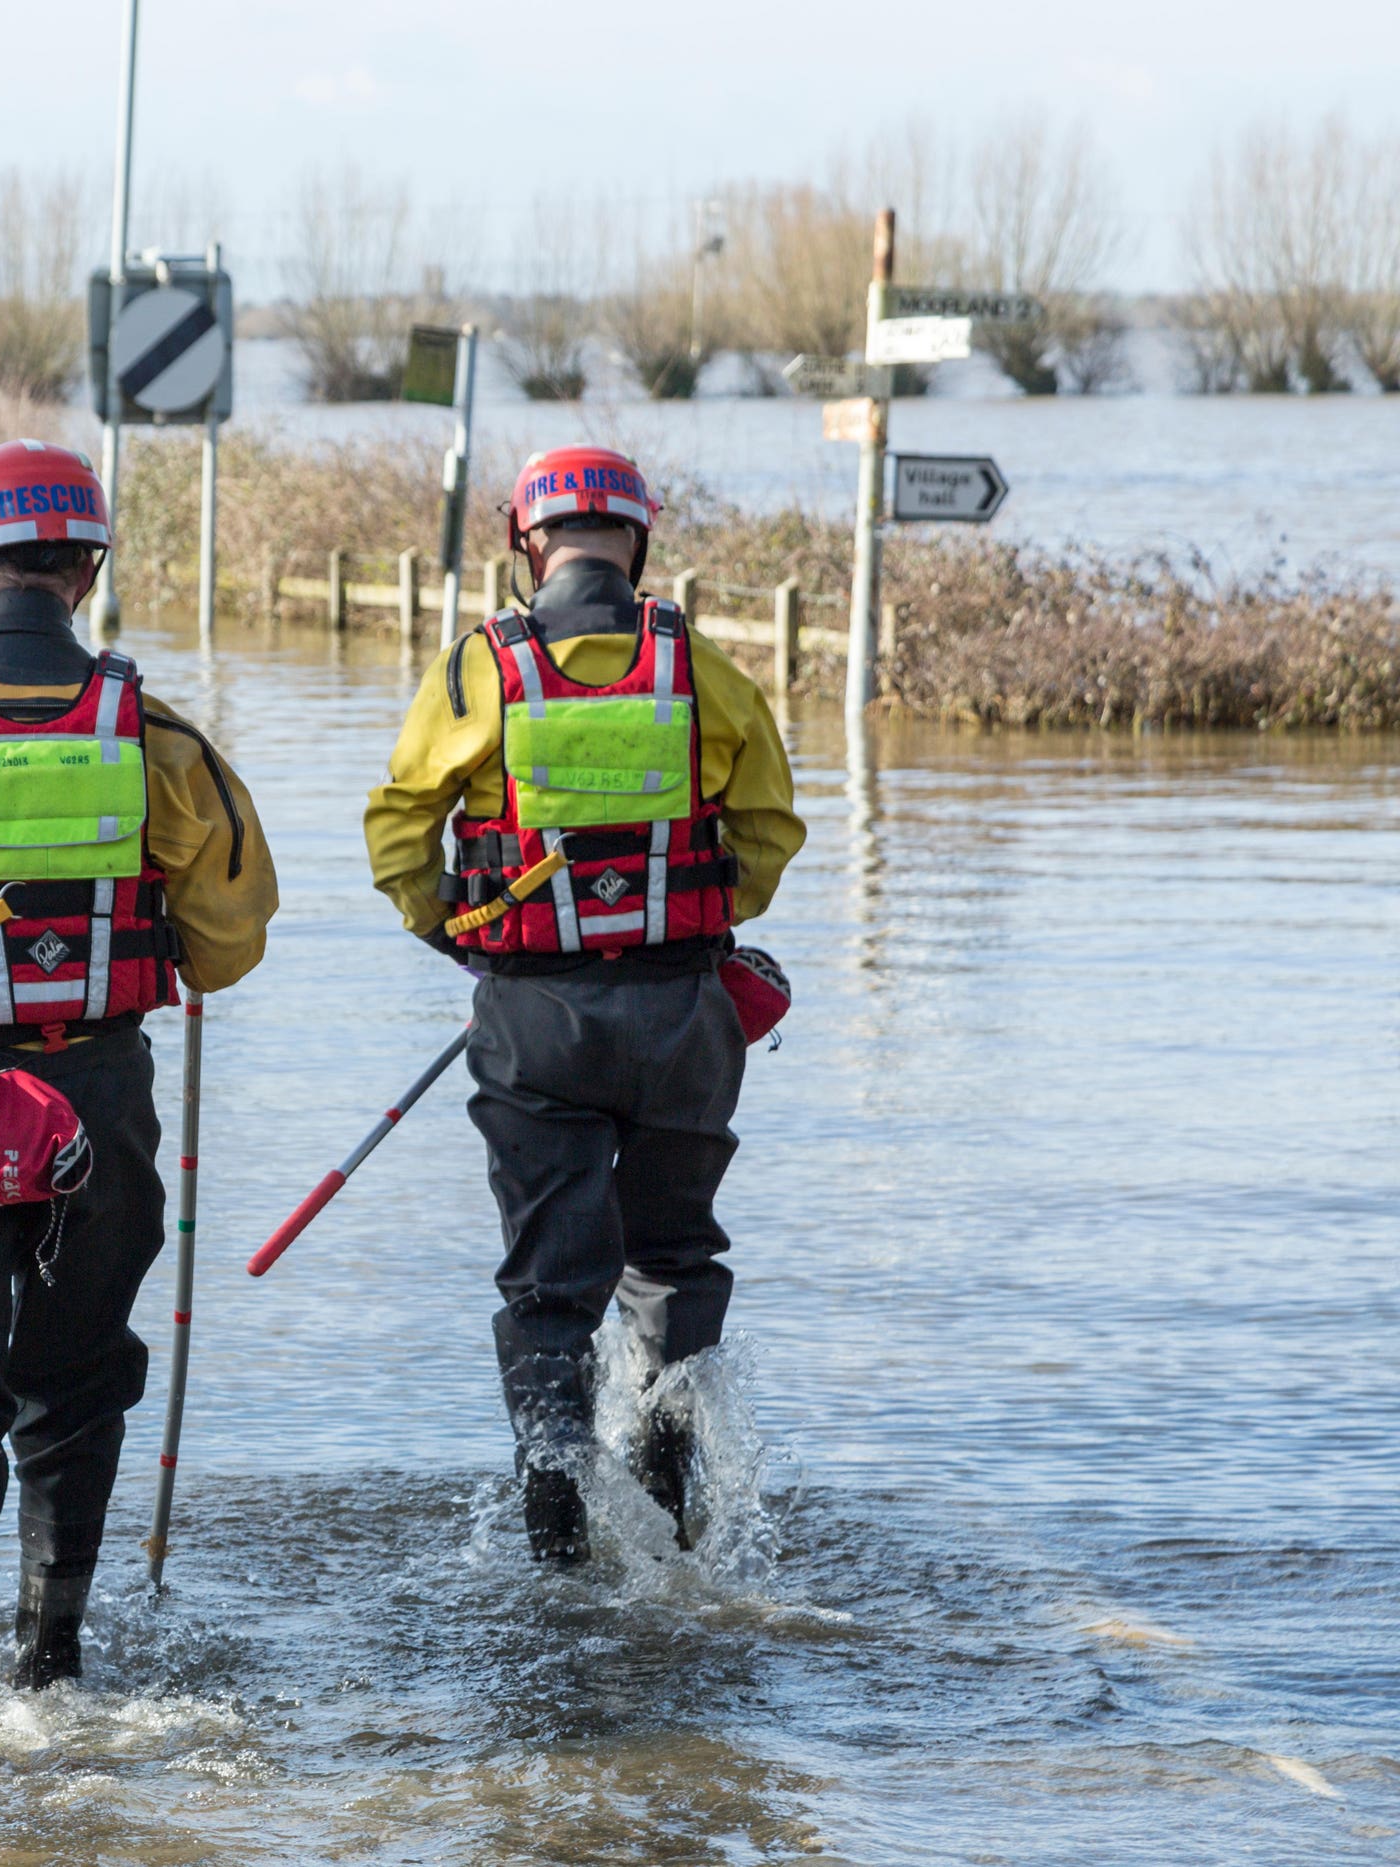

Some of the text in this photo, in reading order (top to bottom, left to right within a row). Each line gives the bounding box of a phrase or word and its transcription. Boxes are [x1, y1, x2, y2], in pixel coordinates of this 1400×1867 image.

[905, 468, 969, 487] Village
[525, 472, 559, 505] FIRE
[564, 472, 579, 490] &
[919, 488, 955, 505] hall
